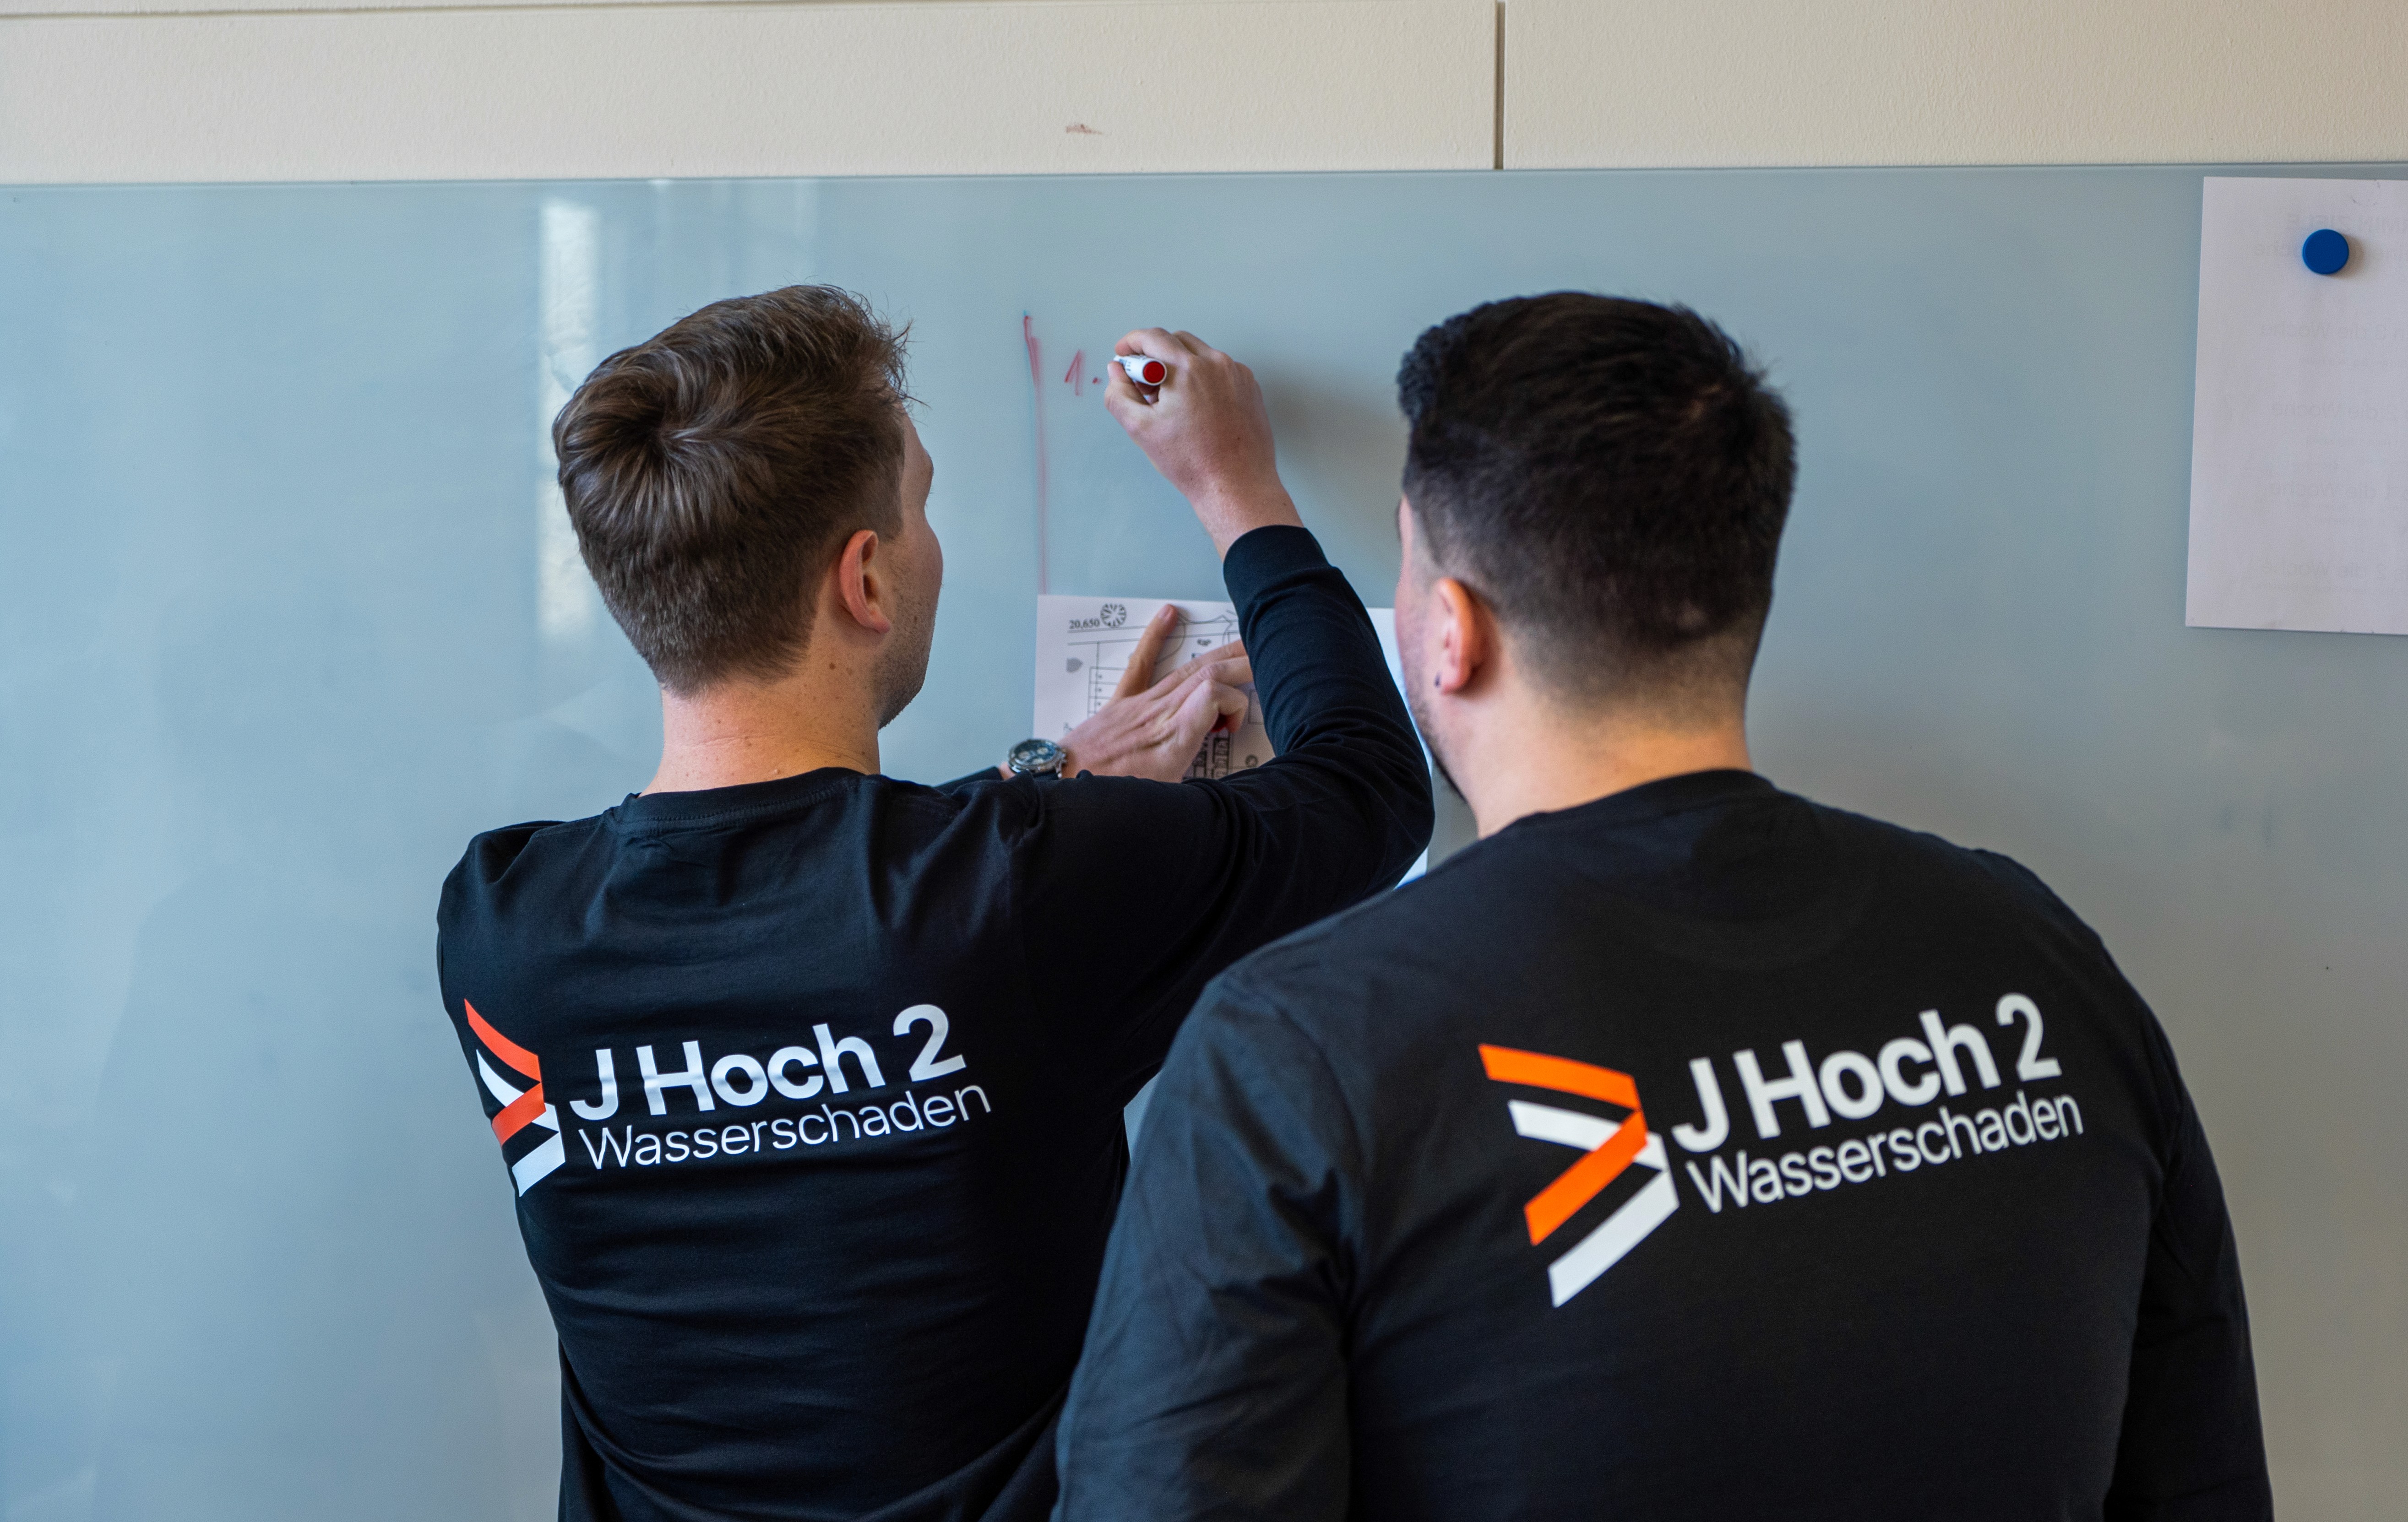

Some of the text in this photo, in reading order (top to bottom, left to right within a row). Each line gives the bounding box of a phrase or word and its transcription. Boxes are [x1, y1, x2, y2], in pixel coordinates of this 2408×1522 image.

[569, 1004, 966, 1121] J Hoch 2
[1672, 993, 2062, 1153] J Hoch 2
[578, 1085, 991, 1170] Wasserschaden
[1686, 1090, 2084, 1213] Wasserschaden
